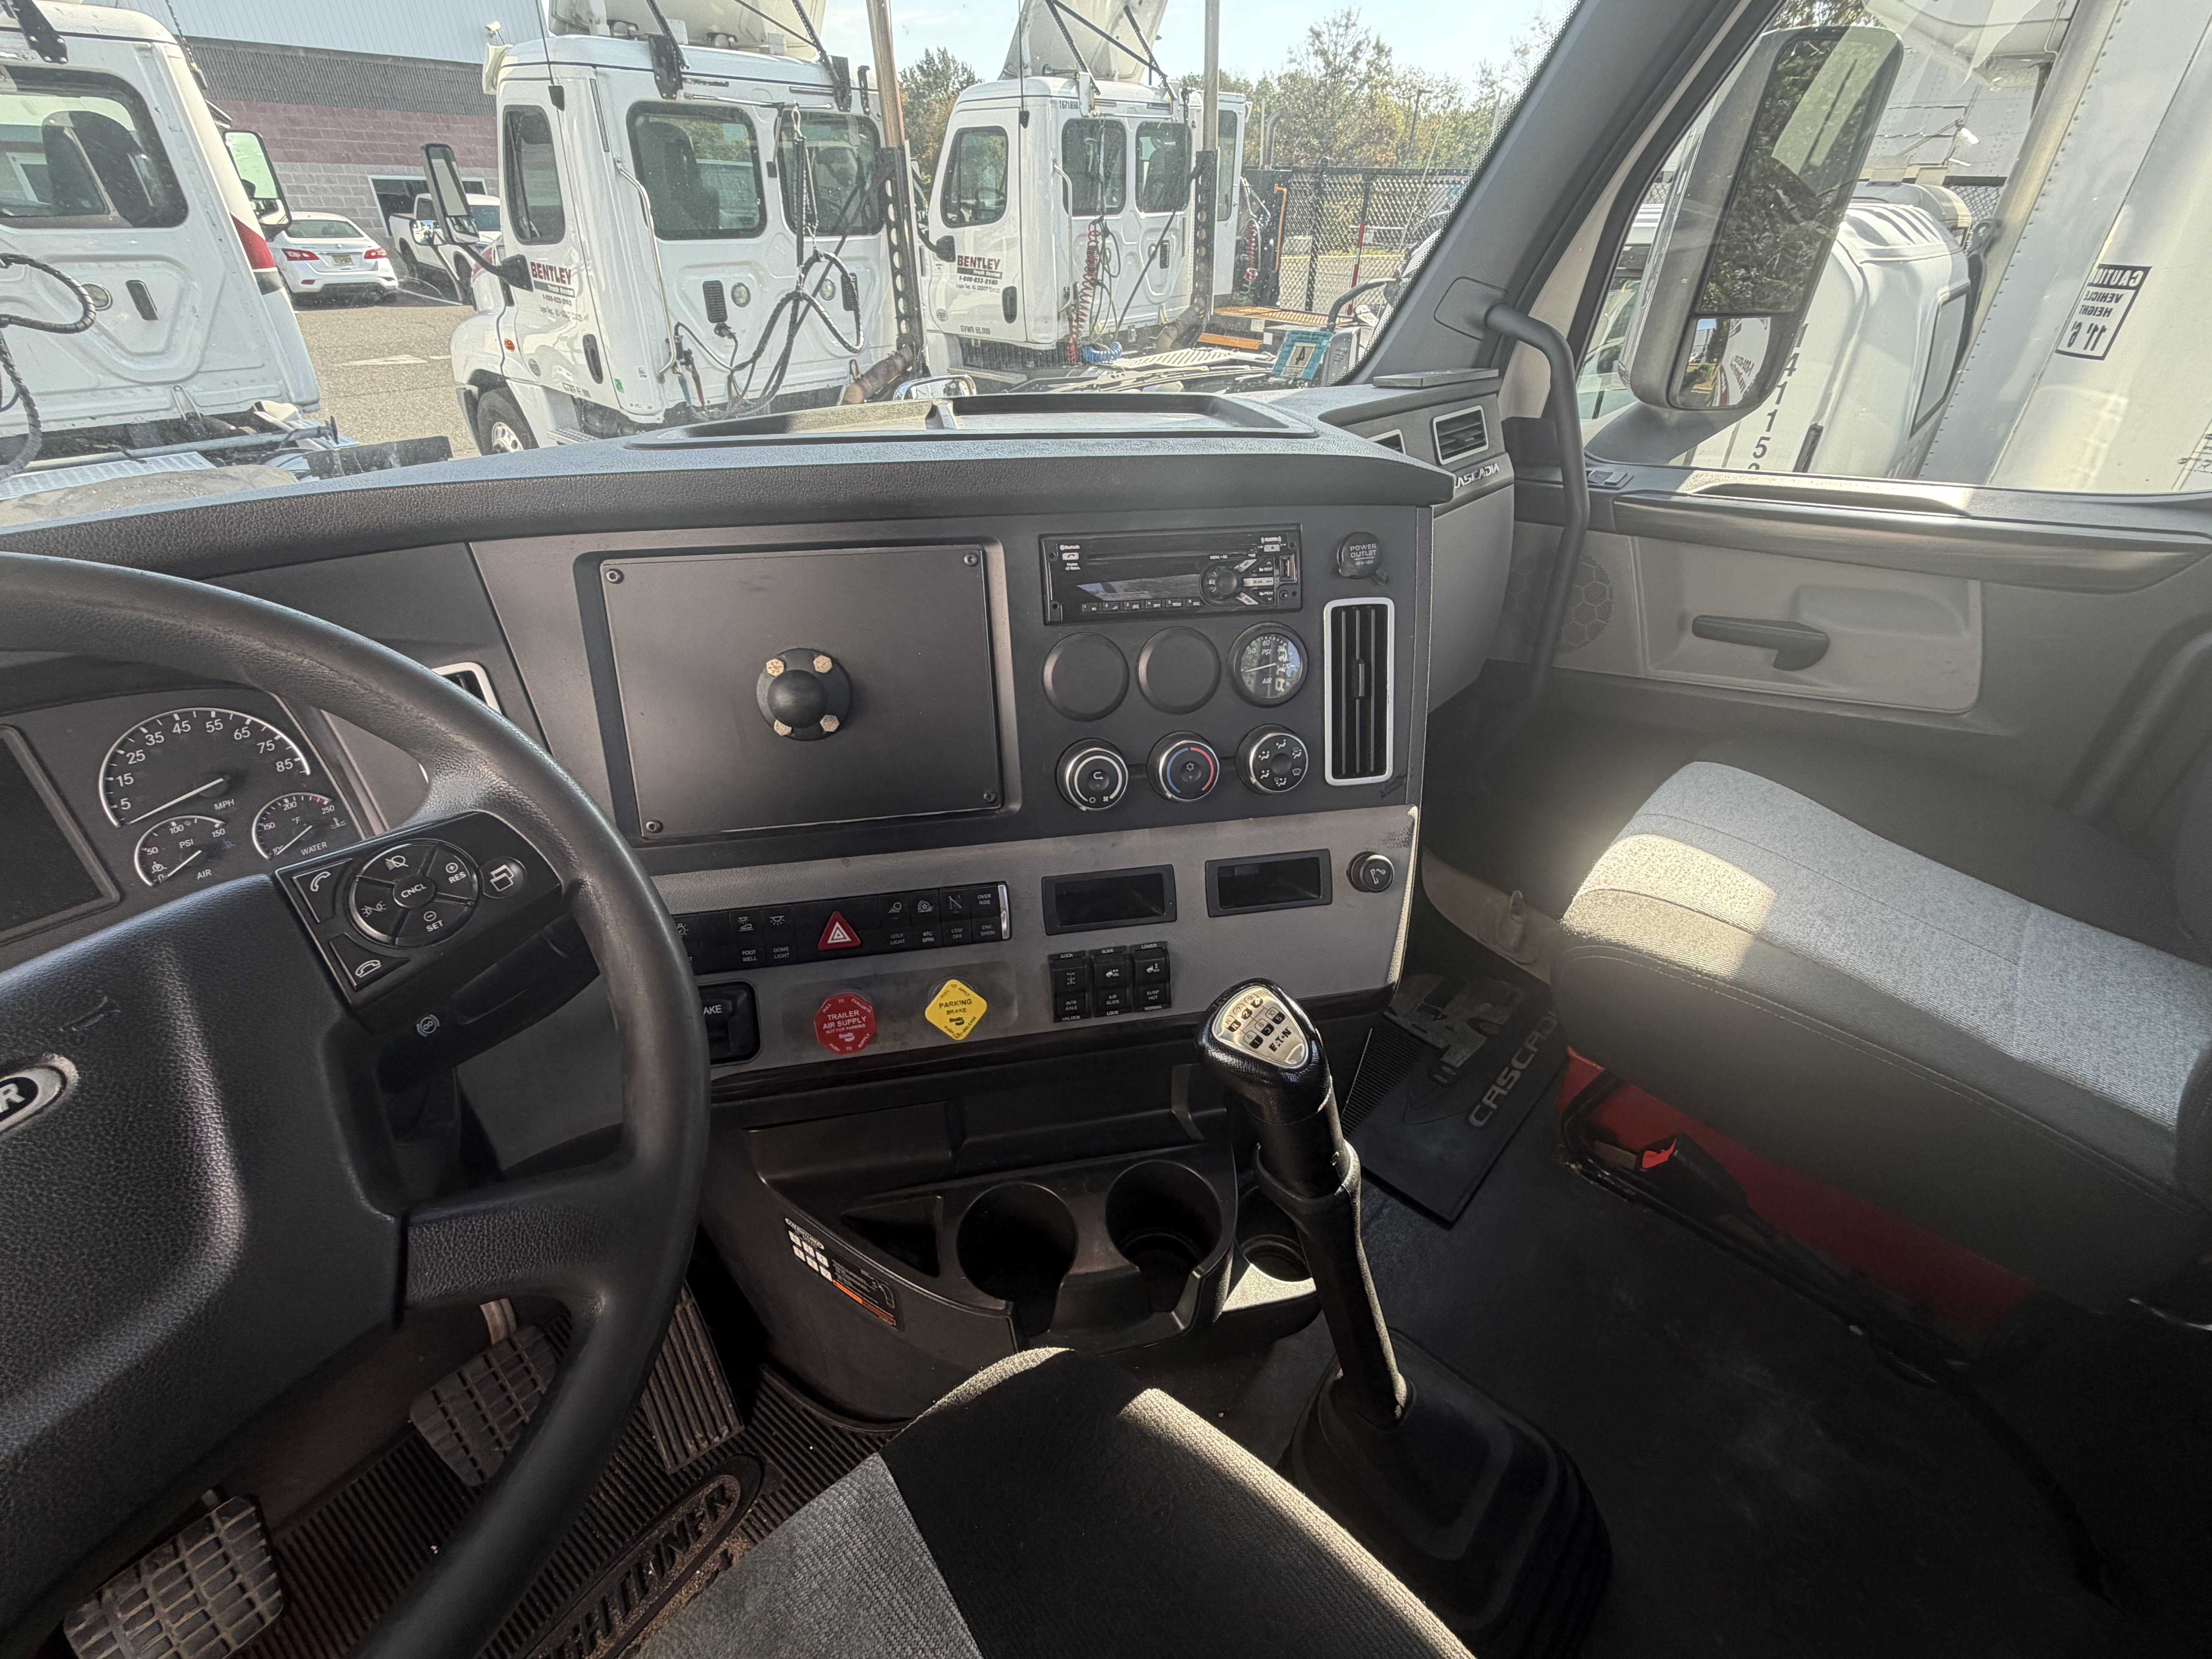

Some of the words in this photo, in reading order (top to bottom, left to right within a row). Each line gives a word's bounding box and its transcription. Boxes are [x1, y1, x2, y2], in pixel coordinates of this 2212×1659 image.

[957, 255, 1001, 270] BENTLEY
[530, 261, 572, 285] BENTLEY
[1455, 463, 1500, 488] ASCADIA
[1350, 543, 1376, 551] POWER
[172, 720, 191, 734] 45
[206, 719, 223, 733] 55
[145, 731, 164, 745] 35
[234, 726, 250, 740] 65
[257, 740, 275, 754] 75
[126, 749, 146, 764] 25
[276, 758, 293, 772] 85
[116, 773, 134, 787] 15
[120, 798, 131, 810] 5
[214, 799, 235, 811] MPH
[283, 801, 297, 811] 200
[321, 805, 335, 814] 250
[170, 824, 184, 834] 100
[263, 822, 276, 831] 150
[212, 828, 225, 838] 150
[179, 838, 194, 849] PSI
[301, 842, 328, 855] WATER
[147, 847, 159, 855] 50
[197, 869, 212, 880] AIR
[448, 871, 466, 884] RES
[401, 883, 427, 898] CNCL
[426, 920, 443, 932] SET
[703, 1005, 722, 1015] AKE
[823, 1003, 831, 1013] PULL
[939, 999, 972, 1009] PARKING
[828, 1010, 859, 1020] TRAILER
[837, 1016, 866, 1027] SUPPLY
[858, 1033, 870, 1048] SUPPLY
